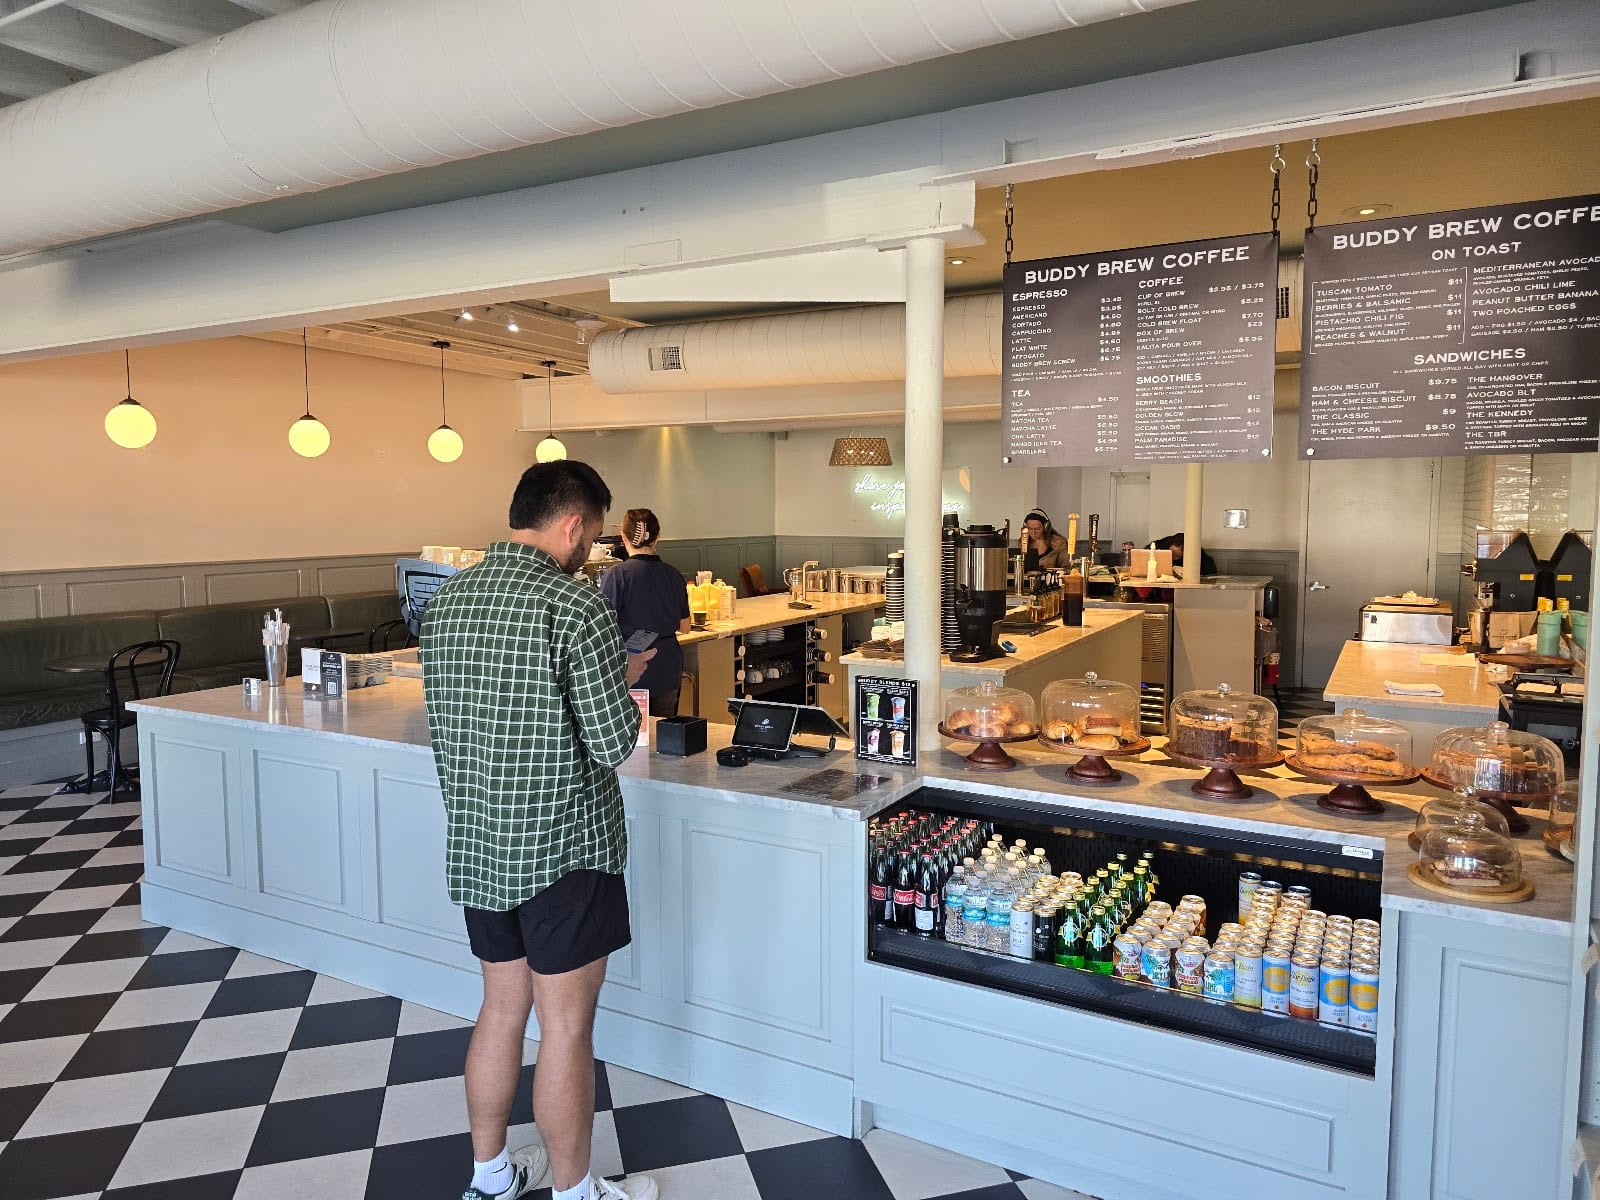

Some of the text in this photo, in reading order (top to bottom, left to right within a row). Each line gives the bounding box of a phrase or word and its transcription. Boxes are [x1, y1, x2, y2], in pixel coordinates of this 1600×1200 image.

[1333, 225, 1418, 250] BUDDY
[1428, 216, 1503, 240] BREW
[1432, 241, 1522, 261] ON TOAST
[1025, 245, 1250, 285] BUDDY BREW COFFEE
[1473, 260, 1556, 273] MEDITERRANEAN
[1139, 277, 1184, 289] COFFEE
[1473, 286, 1520, 295] AVOCADO
[1524, 283, 1549, 291] CHILI
[1013, 289, 1068, 301] ESPRESSO
[1317, 288, 1351, 297] TUSCAN
[1355, 284, 1393, 293] TOMATO
[1472, 289, 1599, 306] PEANUT BUTTER BANANA
[1315, 303, 1352, 312] BERRIES
[1366, 298, 1411, 308] BALSAMIC
[1497, 305, 1544, 315] POACHED
[1548, 302, 1577, 310] EGGS
[1315, 317, 1360, 326] PISTACHIO
[1365, 315, 1386, 323] CHILI
[1315, 333, 1356, 341] PEACHES
[1369, 328, 1405, 337] WALNUT
[1414, 348, 1526, 365] SANDWICHES
[1136, 373, 1202, 384] SMOOTHIES
[1490, 373, 1542, 382] HANGOVER
[1312, 384, 1343, 392] BACON
[1345, 382, 1380, 390] BISCUIT
[1428, 378, 1458, 386] $9.75
[1467, 390, 1514, 398] AVOCADO
[1311, 399, 1330, 407] HAM
[1342, 397, 1378, 405] CHEESE
[1381, 395, 1416, 403] BISCUIT
[1331, 412, 1369, 420] CLASSIC
